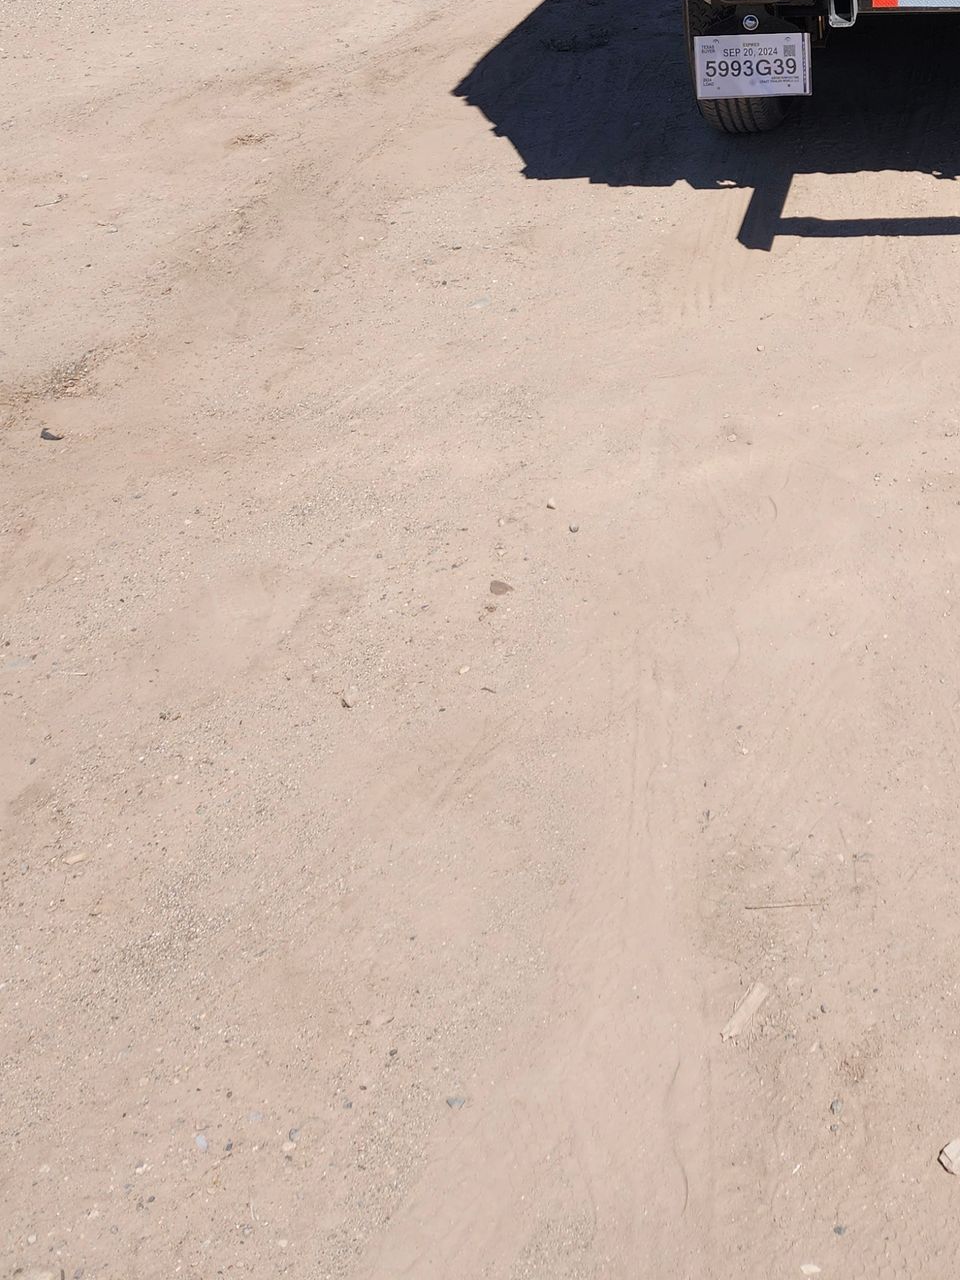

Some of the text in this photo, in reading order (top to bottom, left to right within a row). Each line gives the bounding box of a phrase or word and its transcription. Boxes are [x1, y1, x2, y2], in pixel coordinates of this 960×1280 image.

[723, 47, 778, 58] SEP 20, 2024
[705, 58, 797, 78] 5993G39
